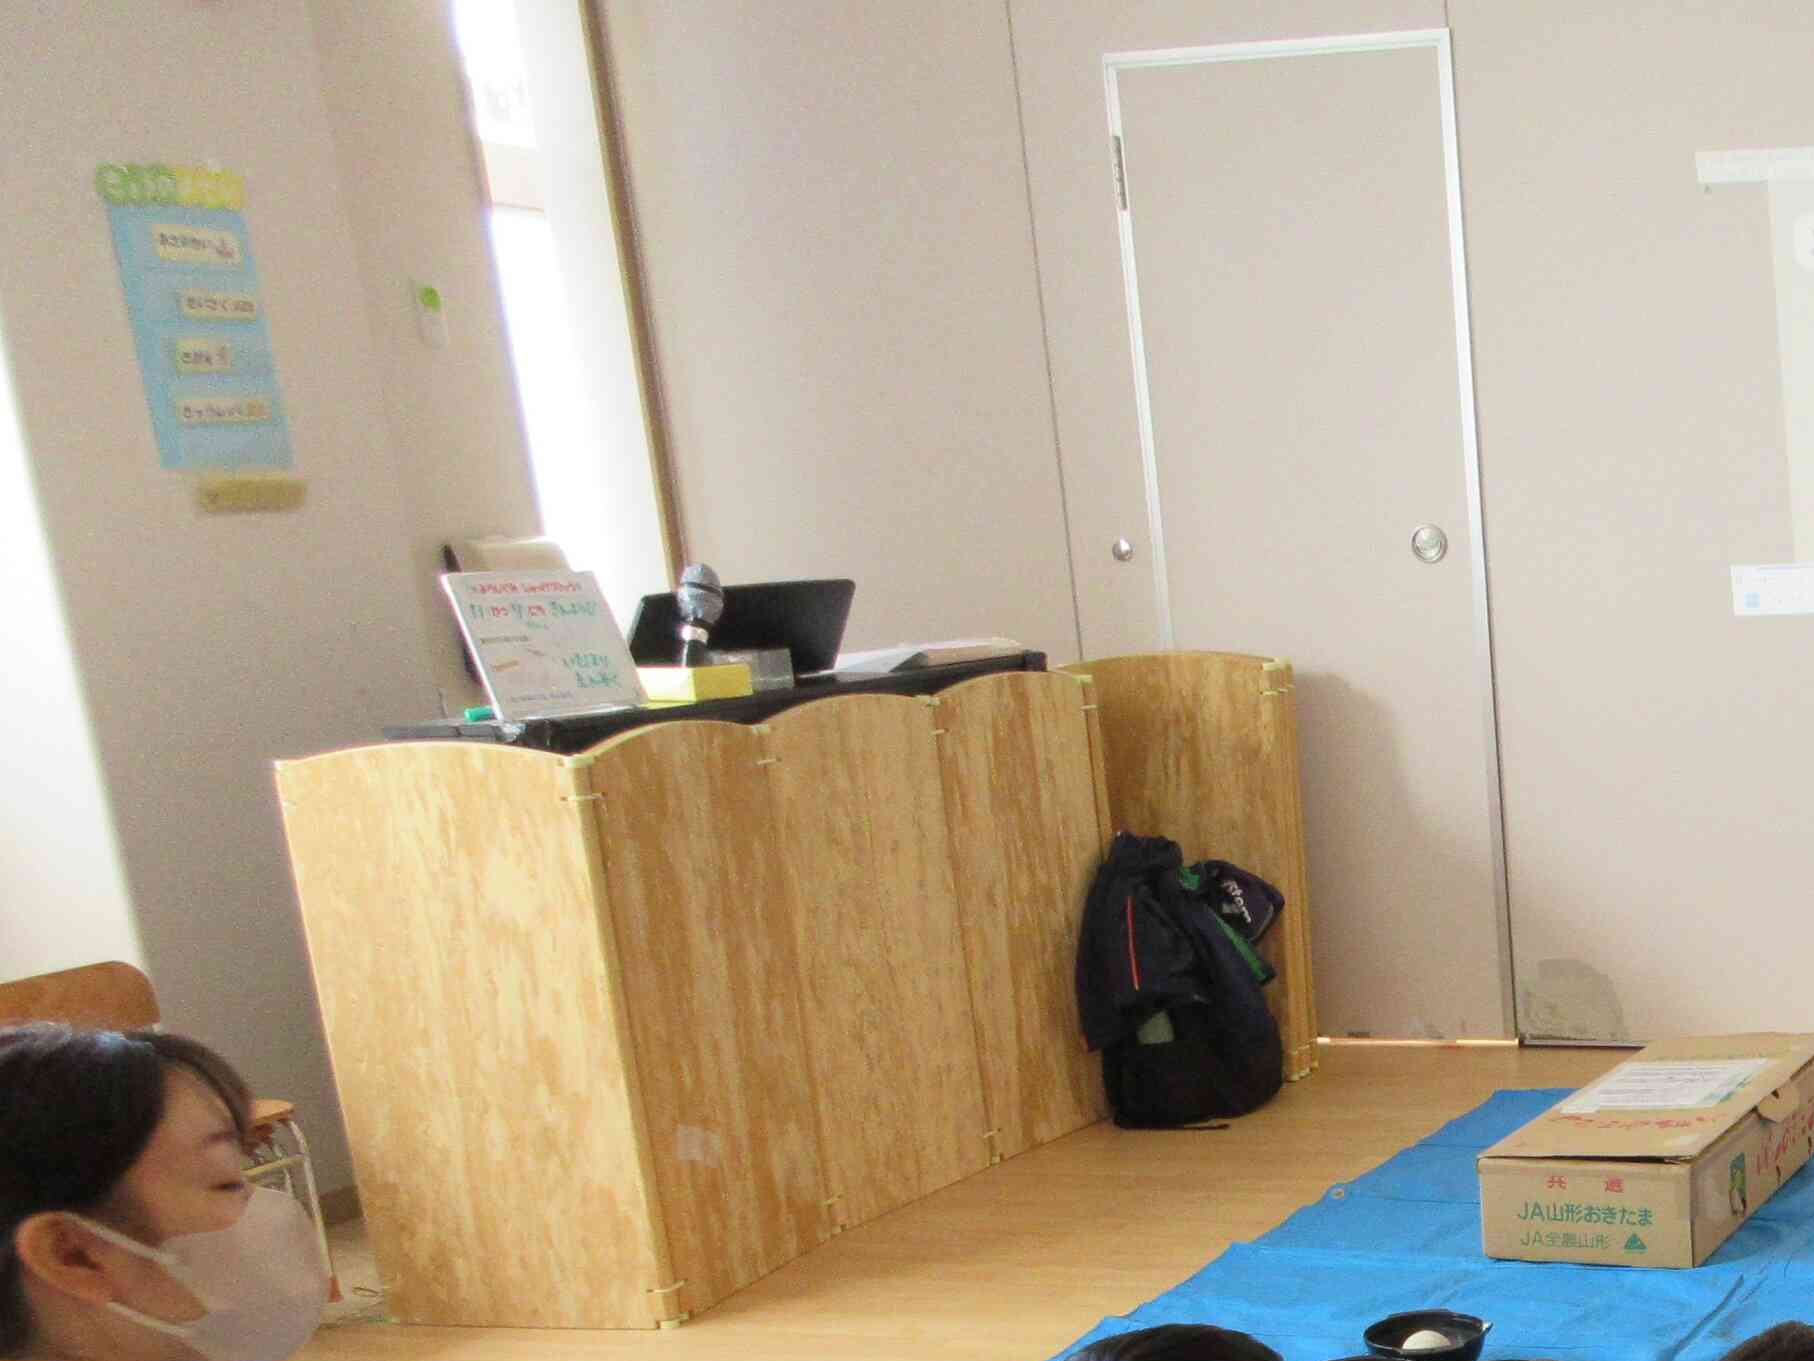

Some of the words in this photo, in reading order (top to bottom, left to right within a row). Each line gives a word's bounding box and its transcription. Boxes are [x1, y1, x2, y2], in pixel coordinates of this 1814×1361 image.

[1518, 1200, 1654, 1227] JA山形おきたま
